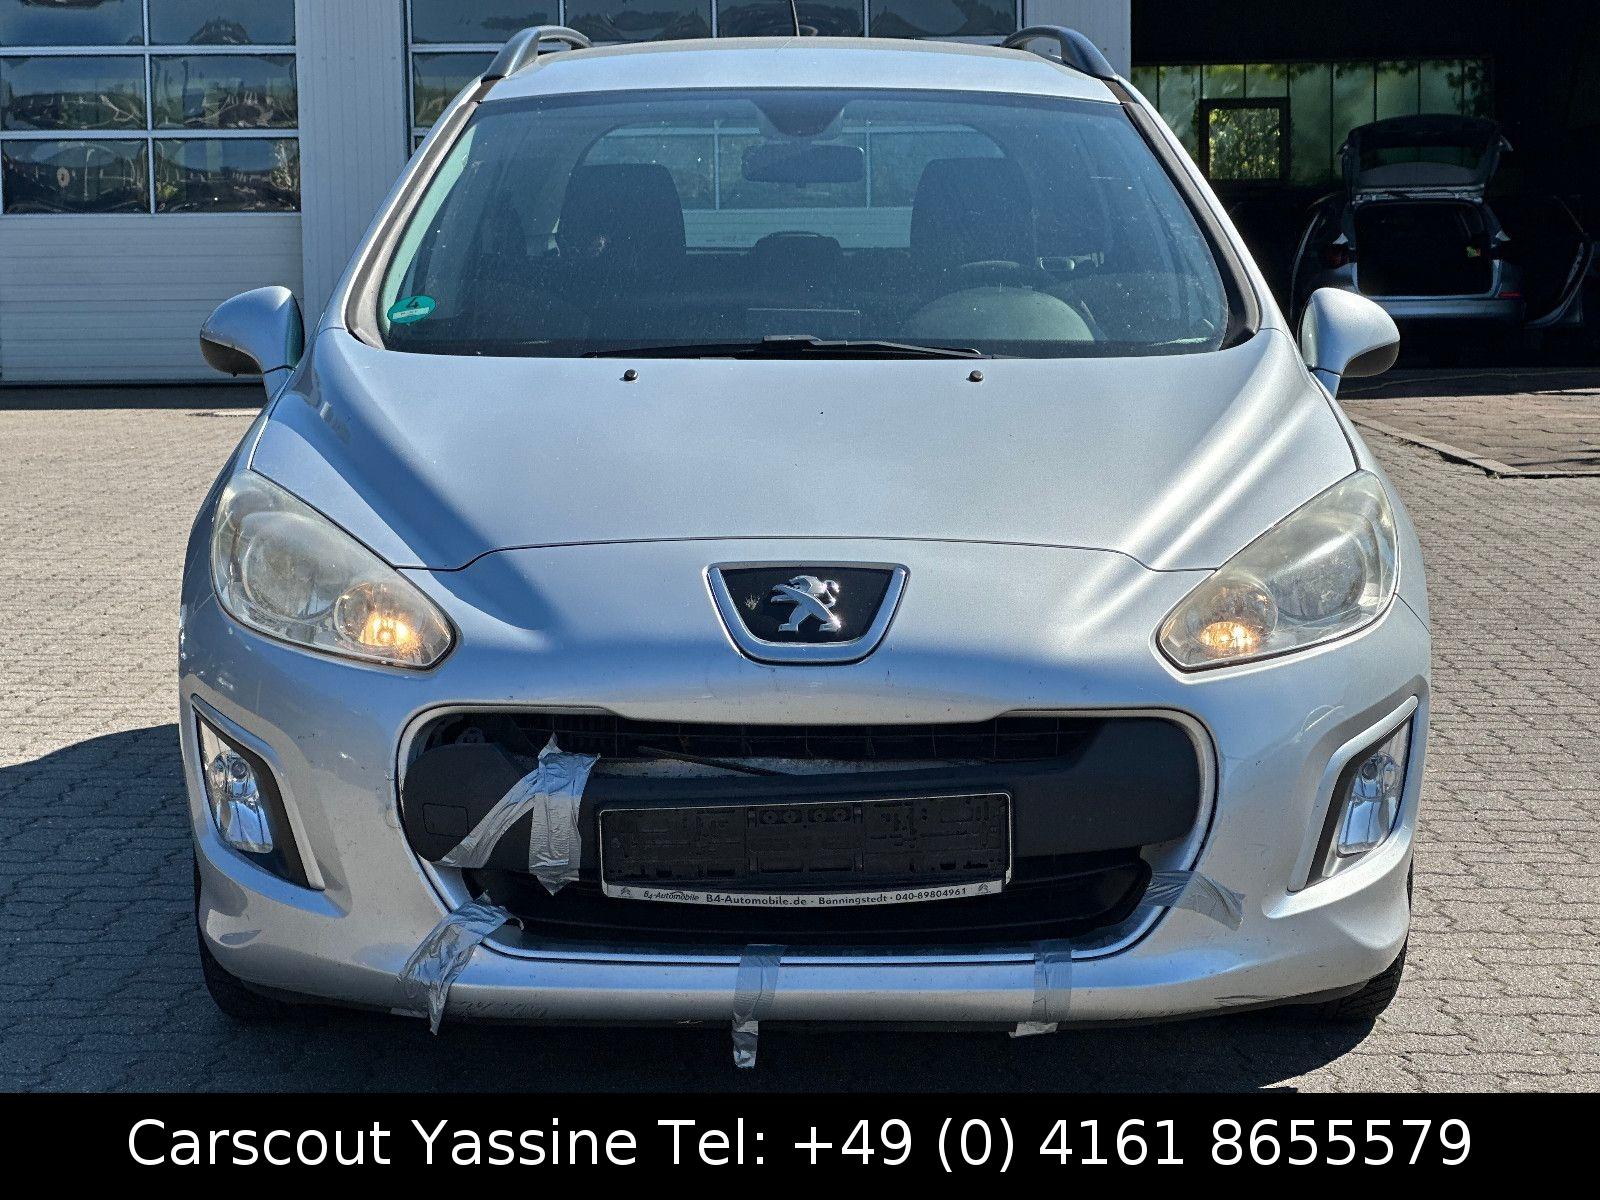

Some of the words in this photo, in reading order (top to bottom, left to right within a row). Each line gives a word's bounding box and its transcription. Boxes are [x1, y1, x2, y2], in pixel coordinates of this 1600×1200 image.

[405, 297, 419, 309] 4
[706, 894, 807, 905] B4-Automobile.de
[895, 888, 966, 901] 040-89804961
